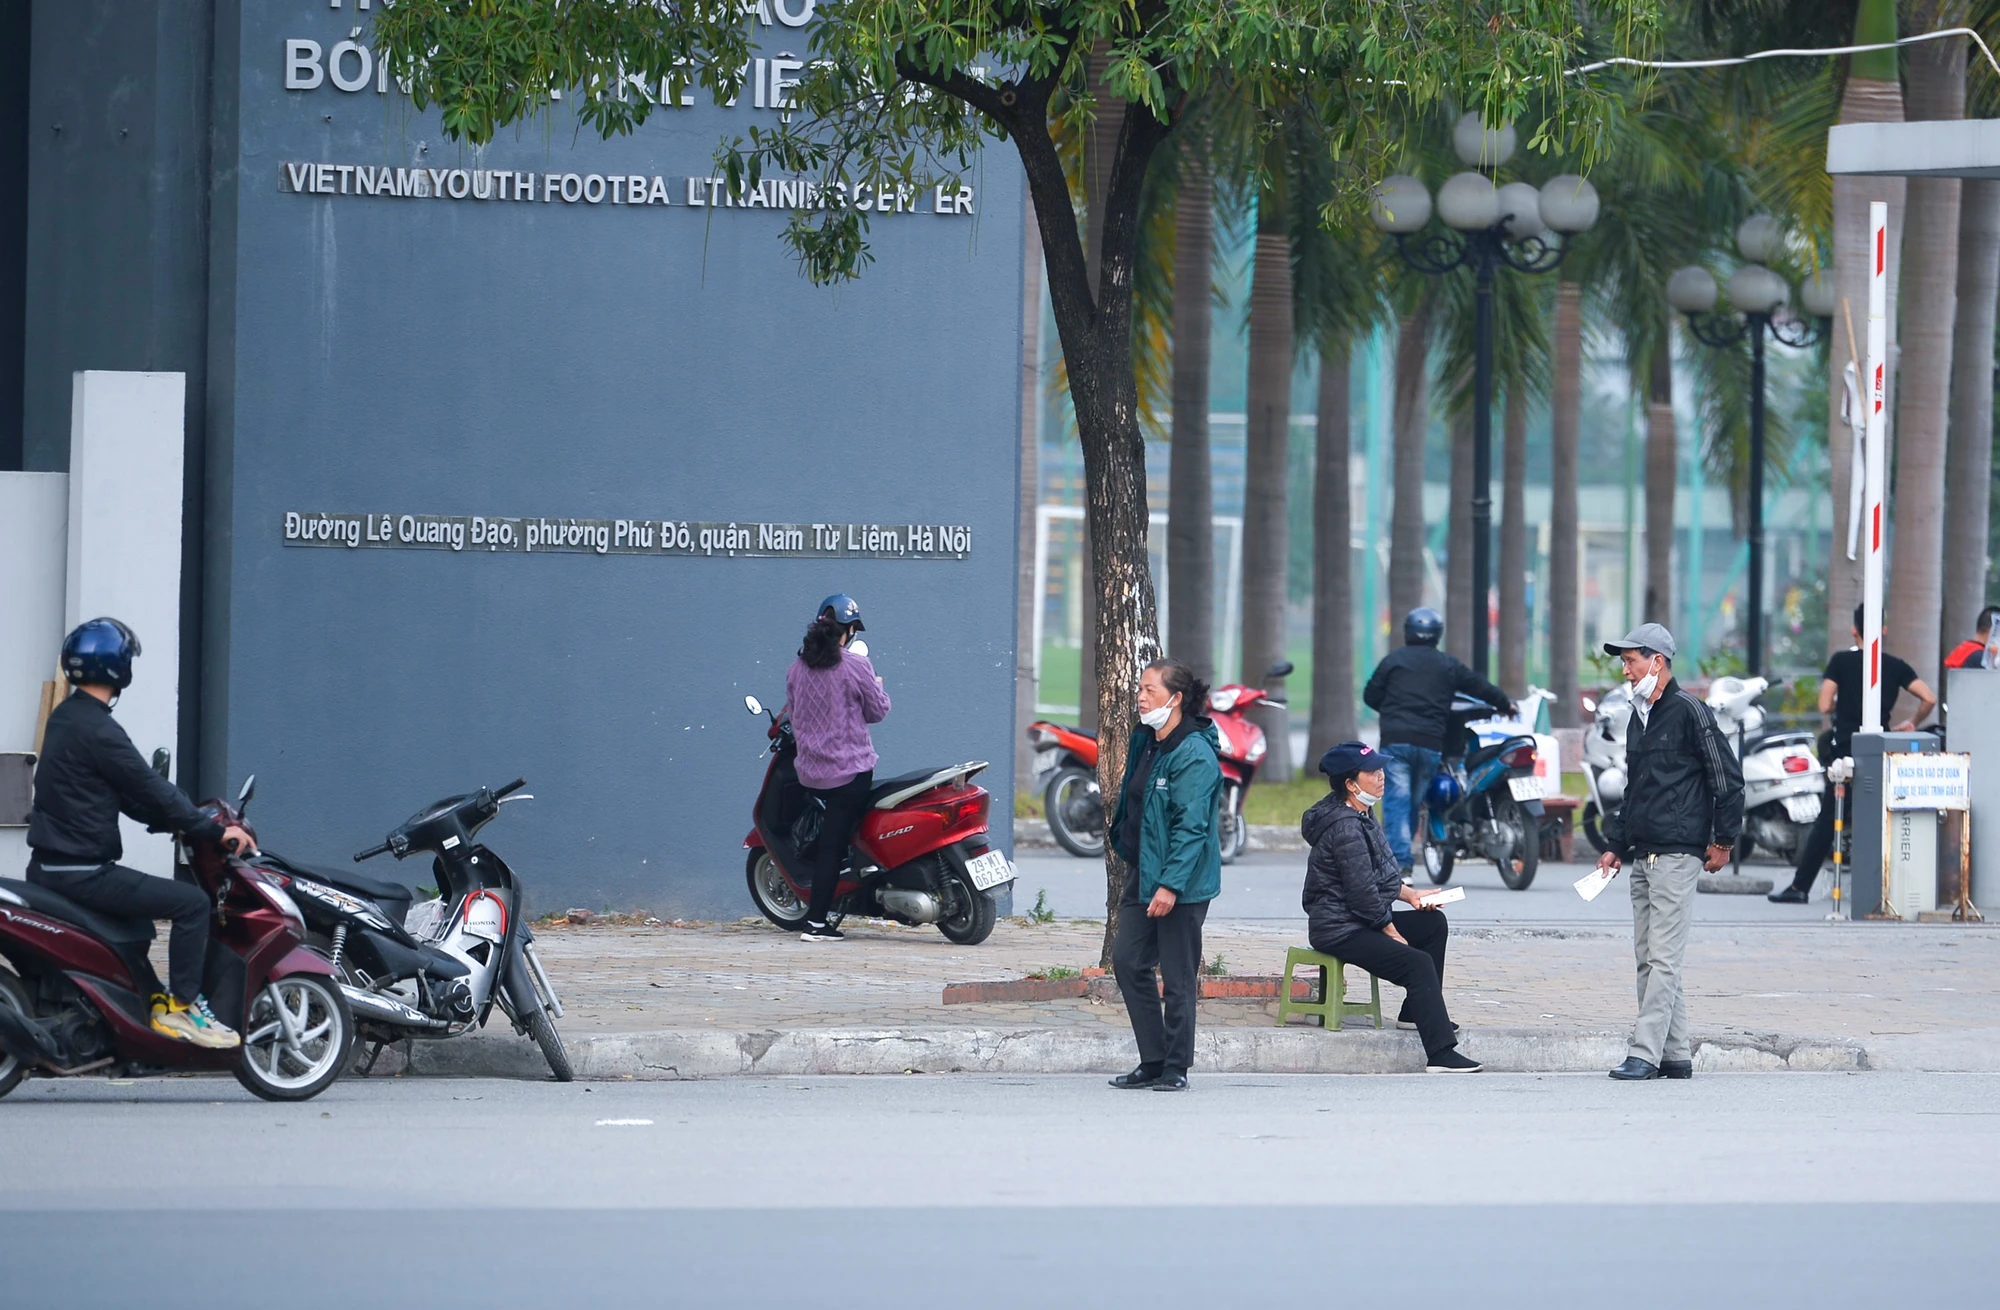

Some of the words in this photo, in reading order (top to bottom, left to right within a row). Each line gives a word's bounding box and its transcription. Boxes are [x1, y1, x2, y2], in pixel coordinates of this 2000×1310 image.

[285, 27, 438, 94] BÓ
[288, 163, 419, 196] VIETNAM
[428, 168, 534, 200] YOUTH
[285, 511, 360, 547] Đường
[366, 514, 392, 541] Lê
[398, 515, 465, 550] Quang
[470, 516, 519, 551] Đạo,
[525, 518, 609, 553] phường
[614, 519, 653, 547] Phú
[660, 520, 695, 550] Đô,
[699, 522, 750, 557] quận
[758, 523, 803, 551] Nam
[811, 523, 840, 551] Từ
[907, 525, 933, 551] Hà
[939, 526, 971, 559] Nội
[878, 825, 914, 840] LEAD
[975, 866, 1010, 888] 062.53
